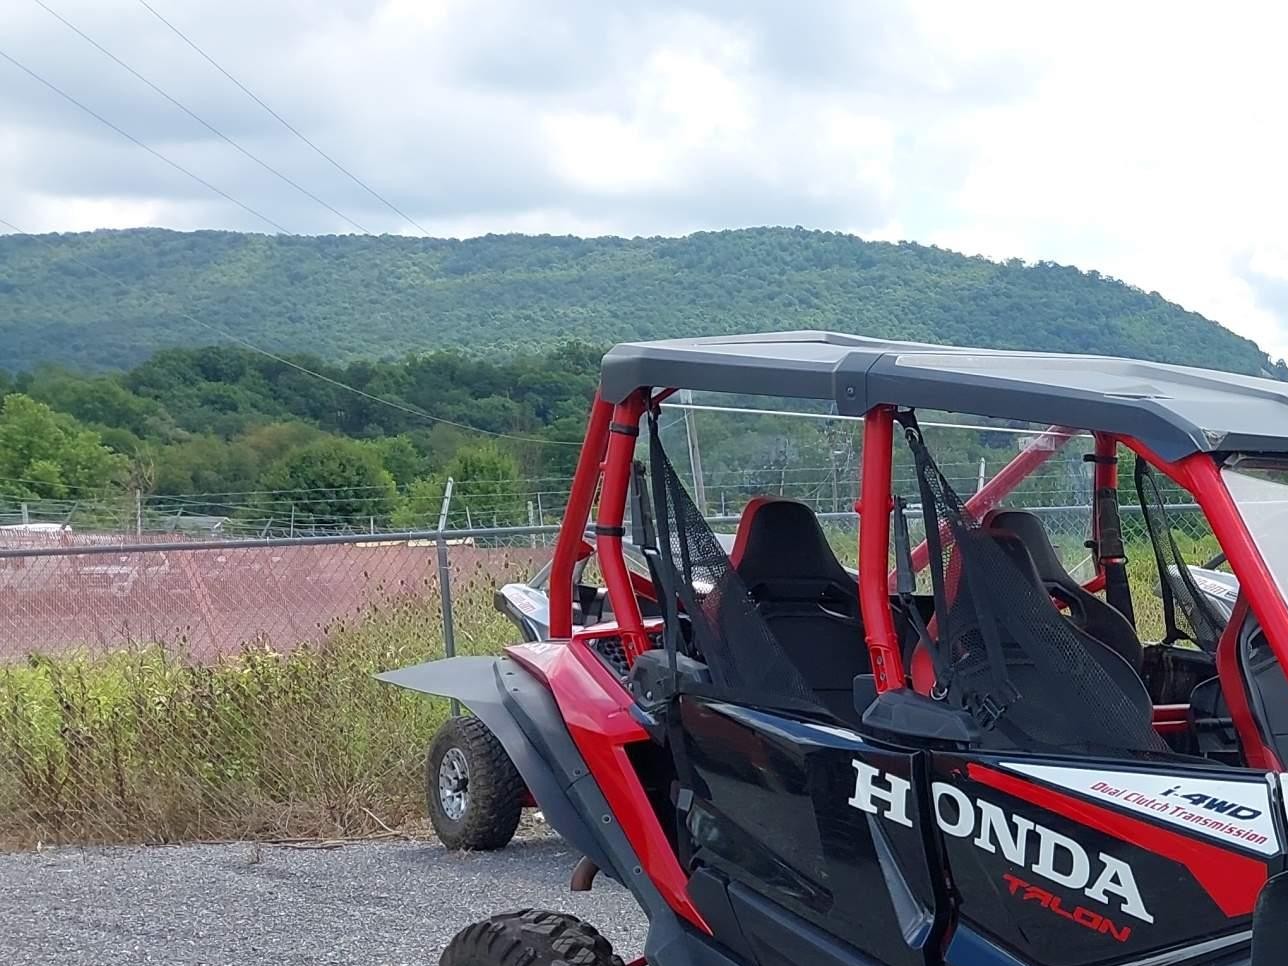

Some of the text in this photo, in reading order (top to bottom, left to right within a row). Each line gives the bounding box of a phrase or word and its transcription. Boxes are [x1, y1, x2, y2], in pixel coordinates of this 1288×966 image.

[1090, 781, 1268, 845] Dual Clutch Transmission
[1160, 785, 1262, 820] i-4WD
[847, 758, 1155, 924] HONDA
[1002, 872, 1134, 943] TALON
